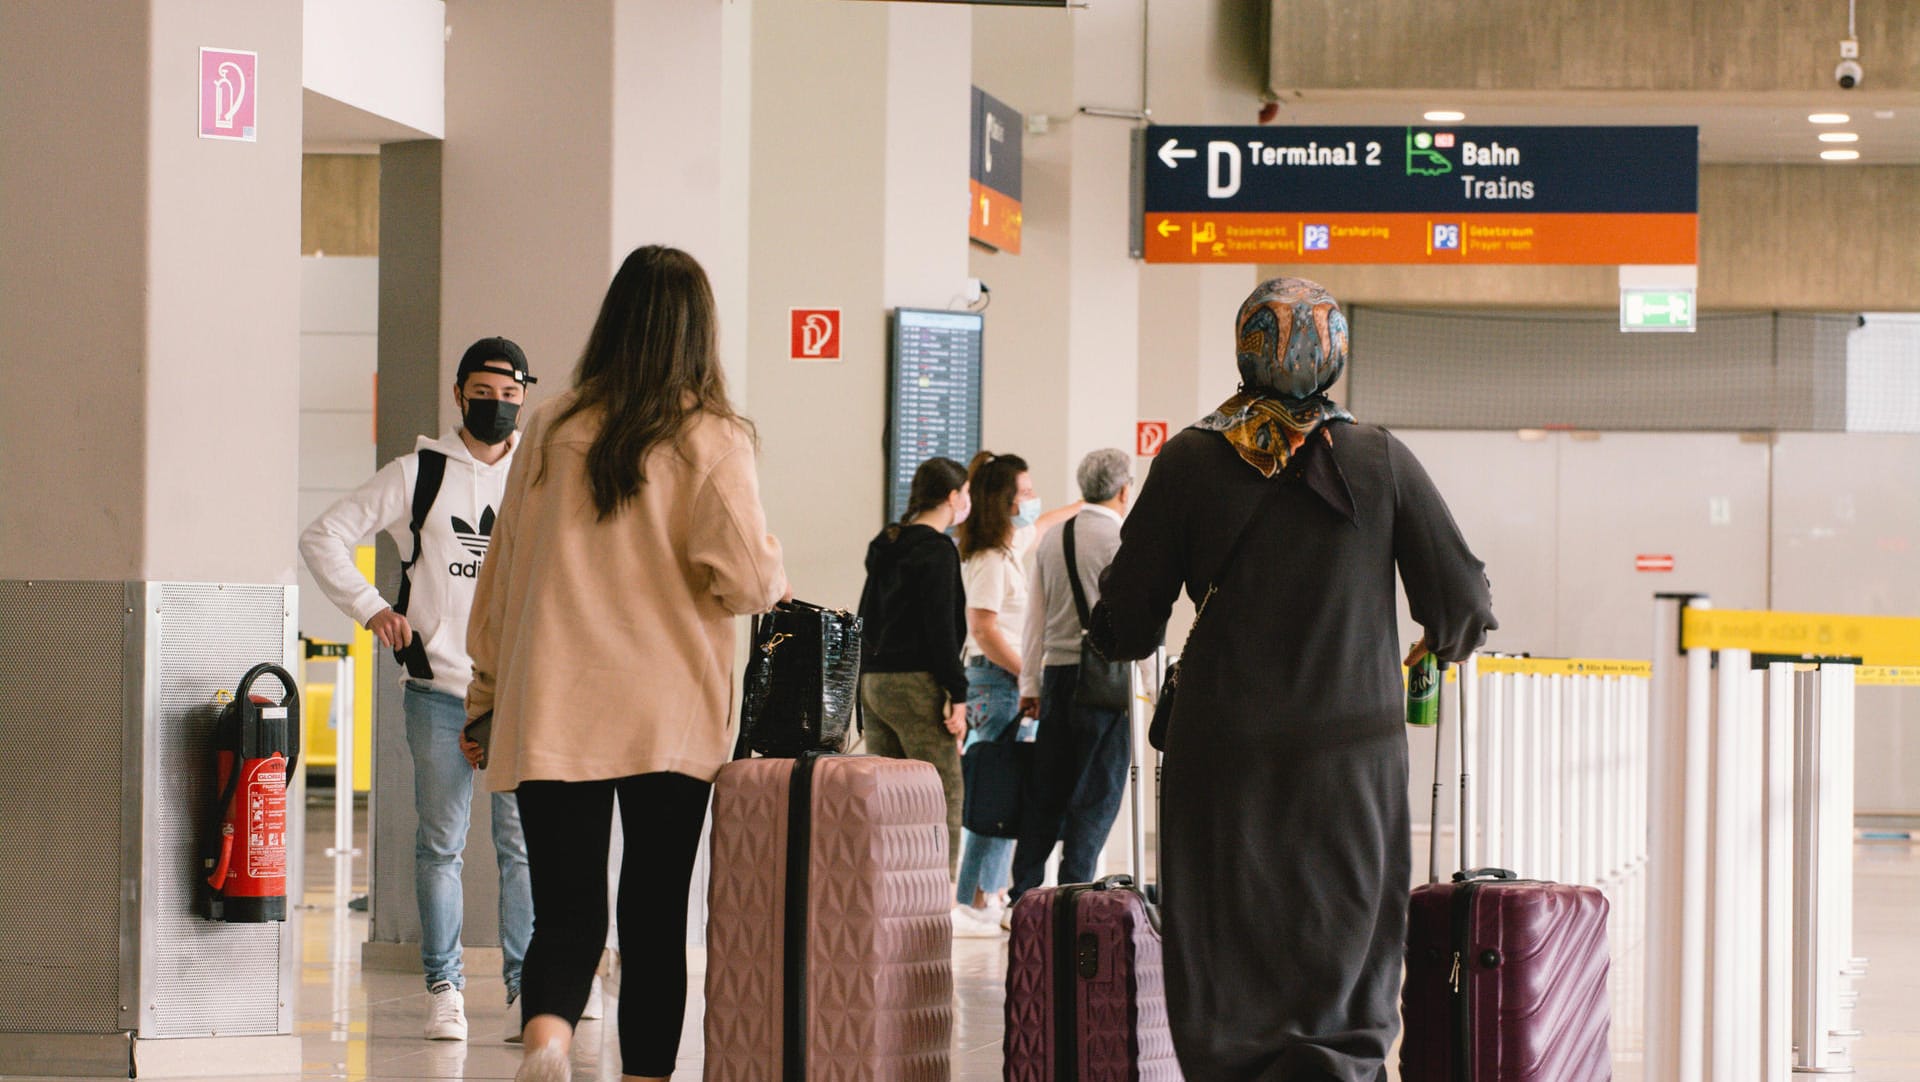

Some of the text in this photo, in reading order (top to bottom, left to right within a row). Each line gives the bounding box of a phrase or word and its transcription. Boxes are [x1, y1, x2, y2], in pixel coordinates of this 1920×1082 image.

[1247, 141, 1382, 166] Terminal 2
[1462, 141, 1520, 166] Bahn
[1207, 140, 1242, 199] D
[1461, 175, 1535, 200] Trains
[1331, 225, 1390, 239] Carsharing
[1470, 225, 1534, 237] Gebetsraum
[1226, 239, 1257, 250] Travel
[1505, 241, 1532, 250] room
